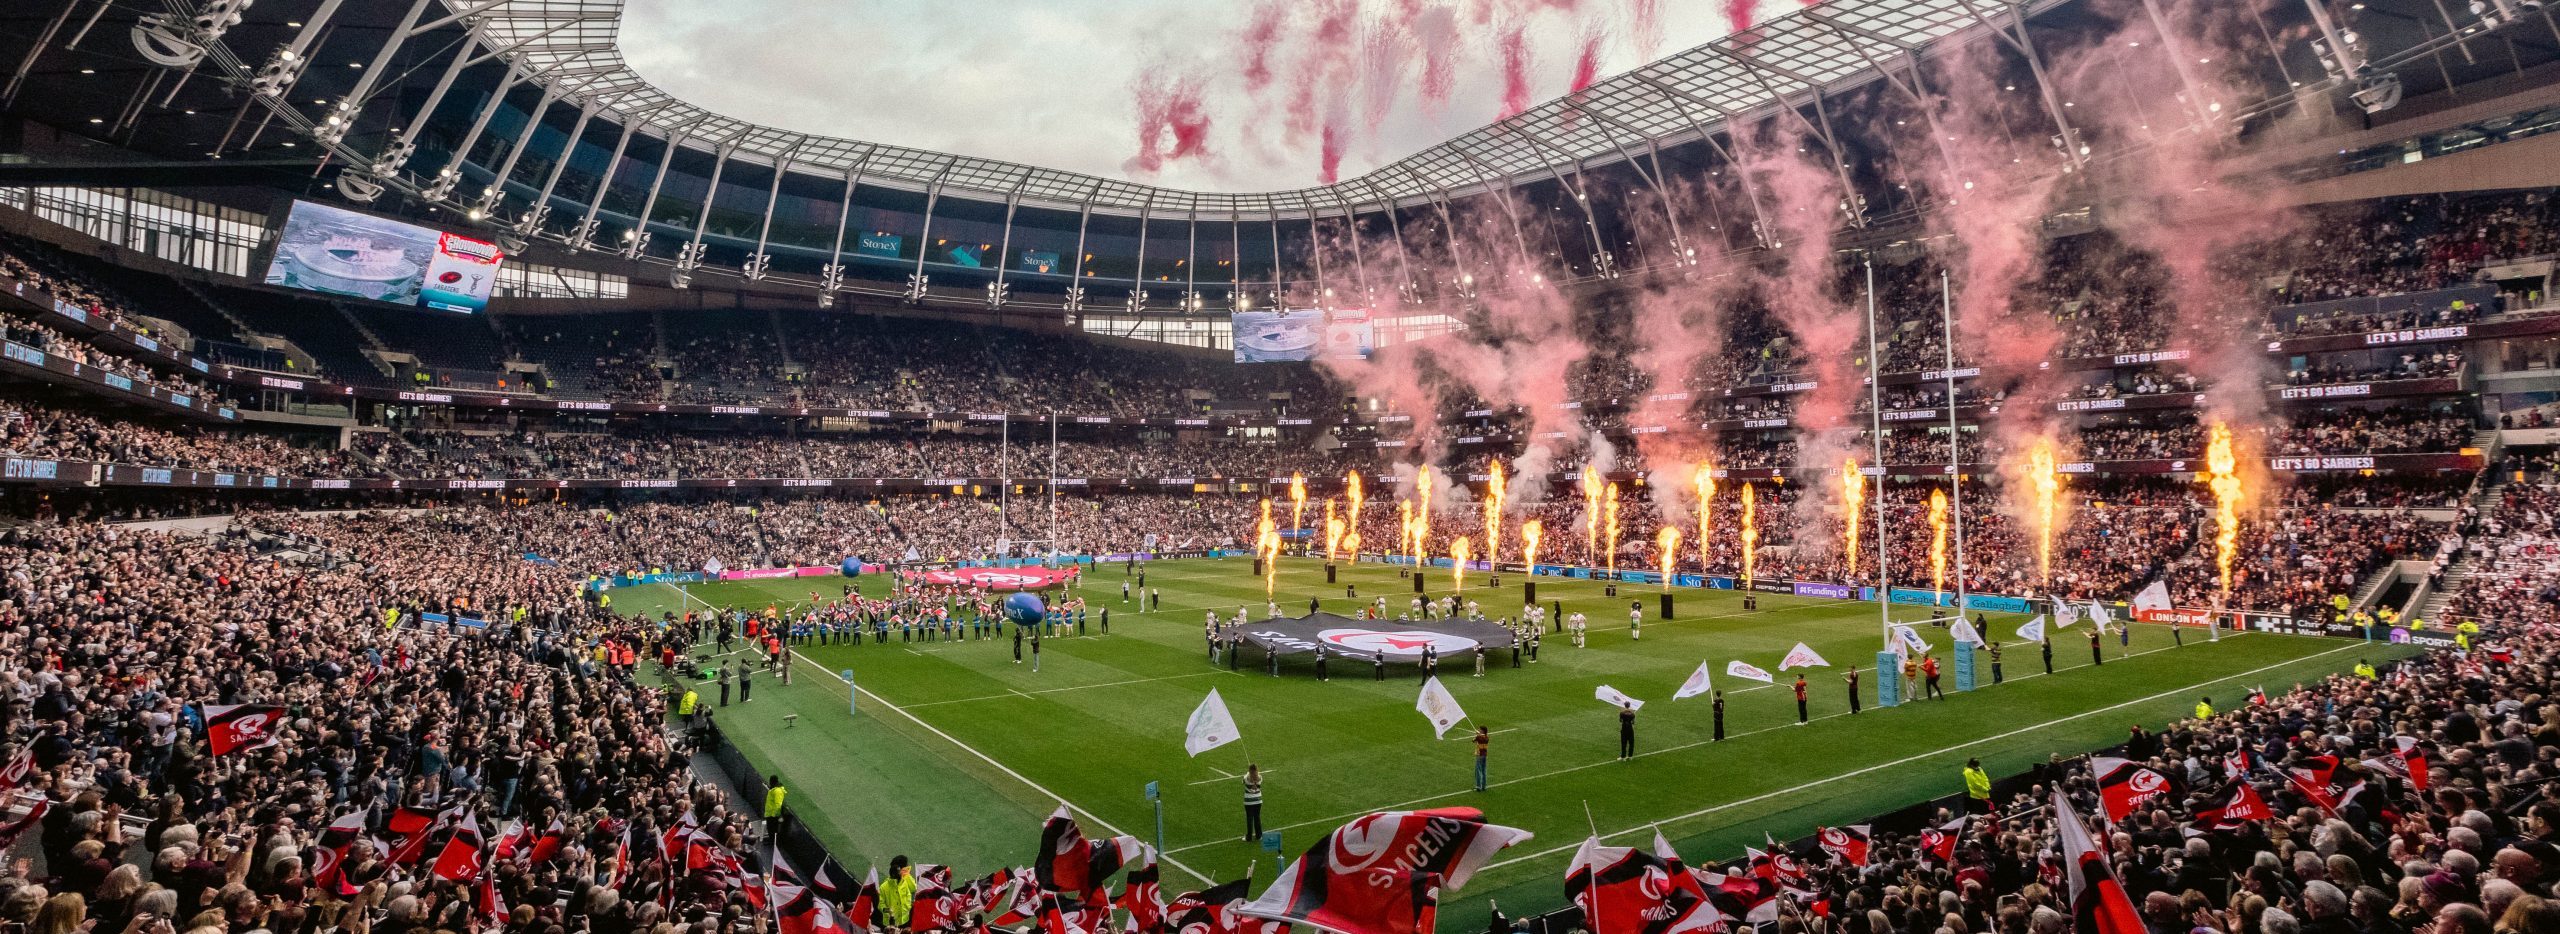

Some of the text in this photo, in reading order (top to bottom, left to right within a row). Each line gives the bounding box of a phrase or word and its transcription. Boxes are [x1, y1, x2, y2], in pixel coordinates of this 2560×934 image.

[862, 238, 897, 250] StoneX
[1024, 256, 1055, 267] StoneX
[2366, 326, 2468, 344] LET'S GO SARRIES!
[2114, 350, 2190, 364] LET'S GO SARRIES!
[1922, 371, 1940, 380] LET'S
[1941, 370, 1950, 379] GO
[274, 378, 281, 387] GO
[1771, 384, 1785, 392] LET'S
[400, 392, 415, 400] LET'S
[2281, 385, 2370, 398] LET'S GO SARRIES!
[2057, 399, 2125, 410] LET'S GO SARRIES!
[1883, 412, 1899, 420] LET'S
[1909, 410, 1936, 419] SARRIES!
[2056, 463, 2094, 472] SARRIES!
[2272, 457, 2374, 470] LET'S GO SARRIES!
[449, 481, 466, 489] LET'S
[477, 481, 506, 489] SARRIES!
[654, 574, 695, 583] StoeX
[1686, 577, 1721, 589] StoX
[1807, 587, 1837, 597] Funding
[1893, 593, 1936, 604] Gallaghe
[1971, 599, 2022, 612] Gallagher
